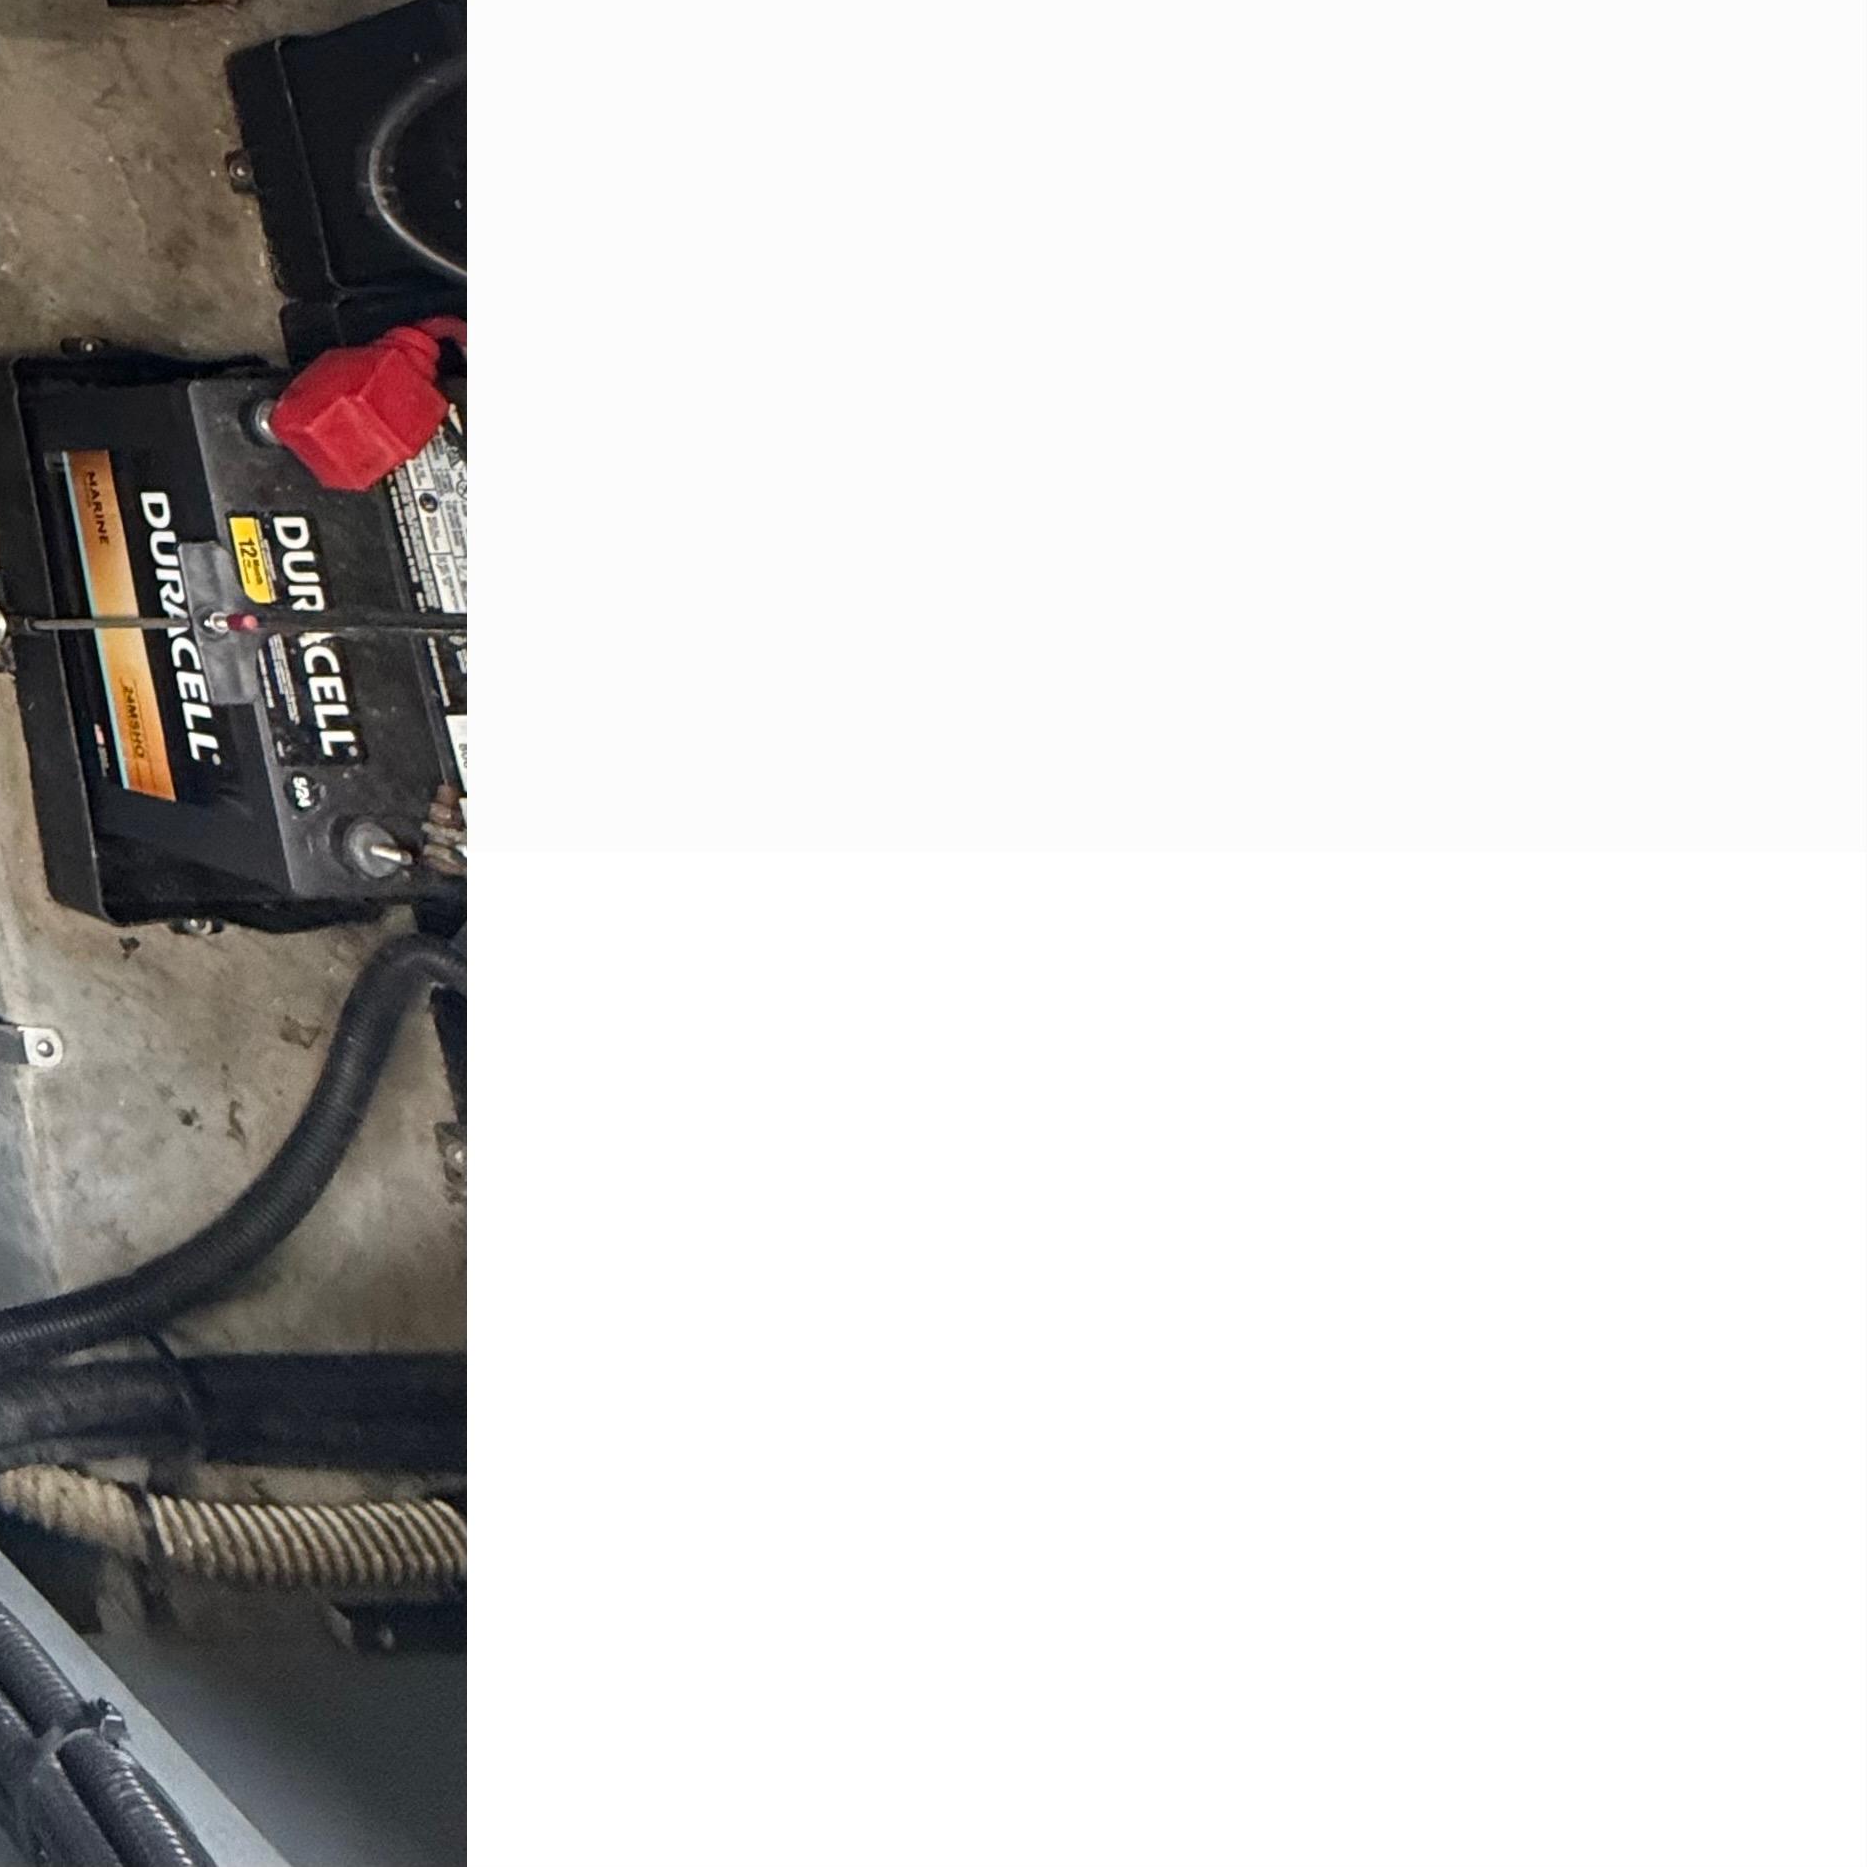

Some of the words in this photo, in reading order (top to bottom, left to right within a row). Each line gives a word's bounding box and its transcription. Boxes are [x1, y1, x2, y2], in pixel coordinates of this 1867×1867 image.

[85, 470, 110, 545] MARINE
[238, 537, 258, 559] 12
[140, 491, 219, 761] DURACELL
